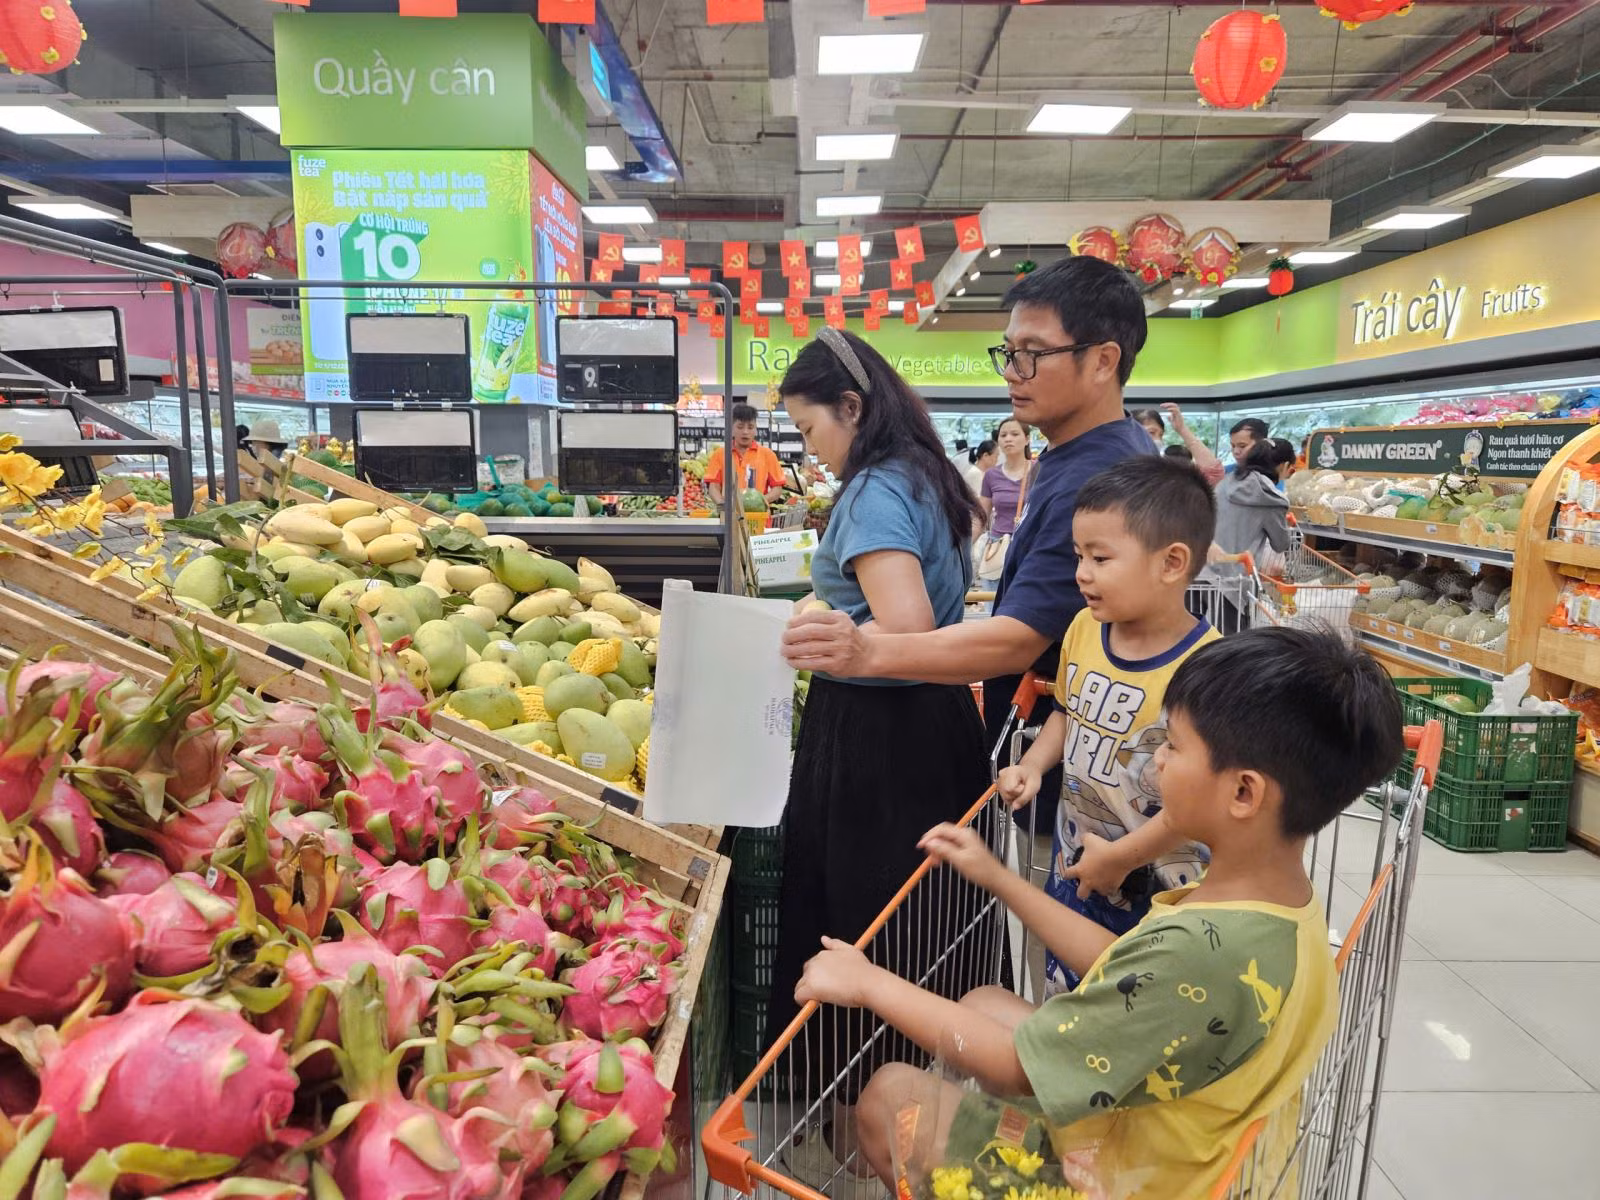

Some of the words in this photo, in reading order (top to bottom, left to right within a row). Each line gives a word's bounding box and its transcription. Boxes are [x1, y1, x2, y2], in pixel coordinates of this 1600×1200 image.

[313, 49, 417, 105] Quầy
[429, 57, 496, 97] cân
[298, 155, 326, 168] fuze
[299, 165, 321, 177] tea
[376, 212, 395, 234] HỘI
[353, 230, 421, 281] 10
[1352, 291, 1399, 345] Trái
[1407, 277, 1464, 341] cây
[1481, 283, 1542, 319] Fruits
[749, 340, 790, 371] Ra
[890, 353, 996, 377] Vegetables
[1489, 434, 1504, 446] Rau
[1536, 434, 1552, 446] hữu
[1552, 434, 1565, 445] cơ
[1341, 443, 1386, 460] DANNY
[1487, 447, 1507, 461] Ngon
[1508, 447, 1530, 459] thanh
[1486, 462, 1500, 471] Canh
[1500, 462, 1508, 471] tác
[1508, 462, 1520, 471] theo
[753, 537, 791, 545] PINEAPPLE
[755, 556, 787, 564] PINEAPPLE
[1066, 662, 1146, 734] LAB
[1066, 712, 1129, 788] URU
